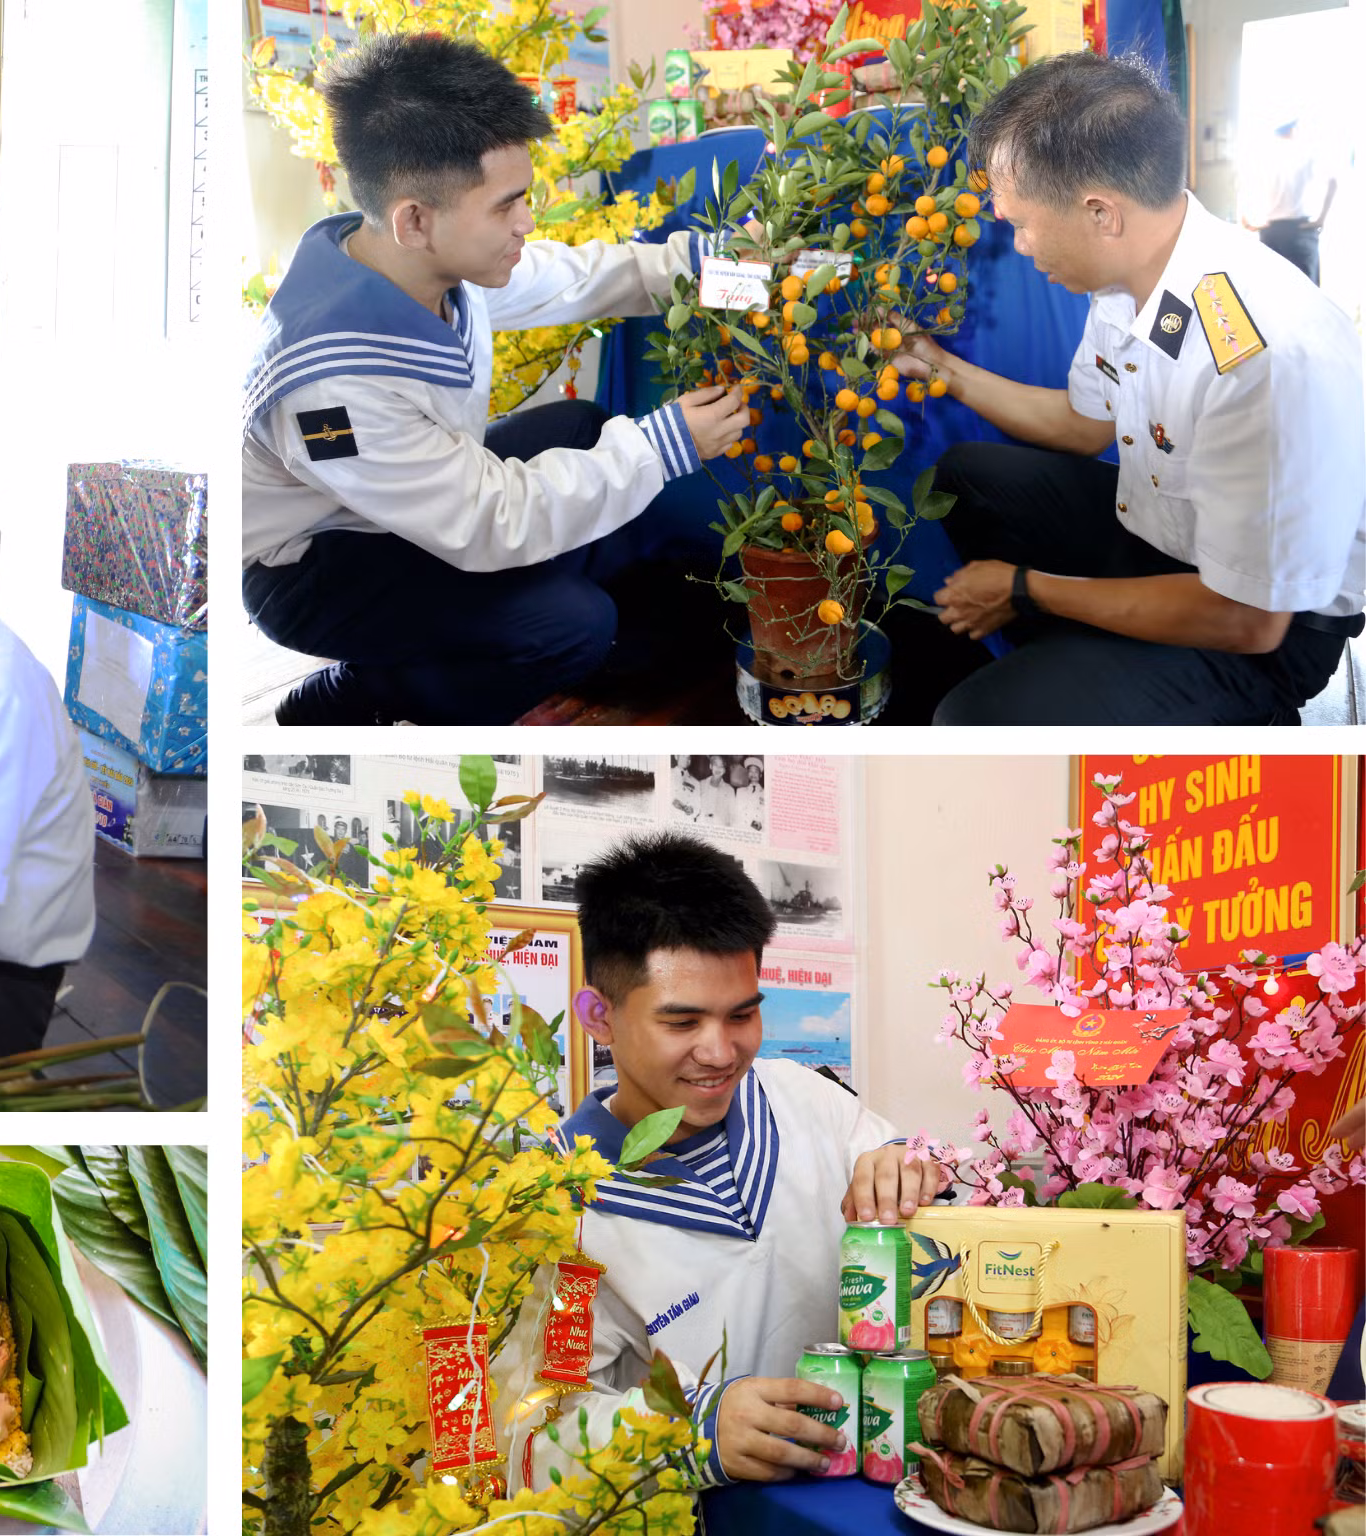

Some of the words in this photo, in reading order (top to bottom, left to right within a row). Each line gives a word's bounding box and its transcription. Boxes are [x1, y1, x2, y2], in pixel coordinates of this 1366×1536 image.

[1138, 777, 1176, 827] HY
[1184, 754, 1261, 814] SINH
[1124, 826, 1203, 888] HẤN
[1211, 803, 1279, 875] ĐẤU
[1203, 876, 1313, 944] TƯỞNG
[513, 948, 538, 968] HIỆN
[541, 952, 559, 970] ĐẠI
[787, 968, 812, 986] HIỆN
[814, 971, 832, 987] ĐẠI
[985, 1263, 1036, 1277] FitNest
[645, 1313, 671, 1336] GUYỄN
[667, 1303, 684, 1321] TẤN
[682, 1291, 700, 1312] GIÀU
